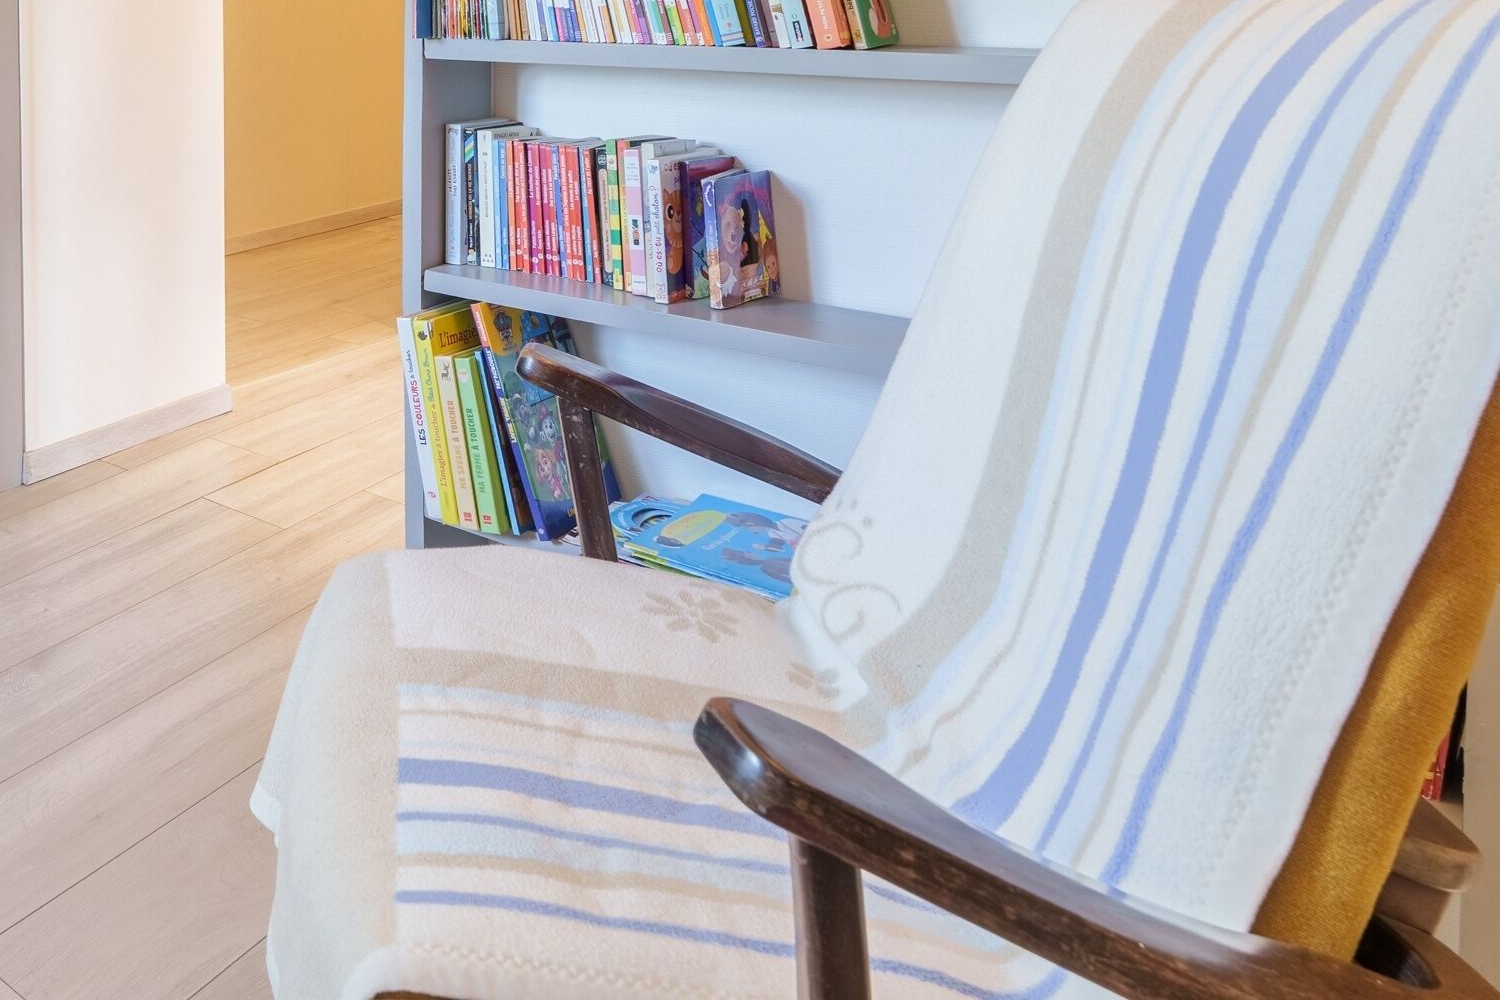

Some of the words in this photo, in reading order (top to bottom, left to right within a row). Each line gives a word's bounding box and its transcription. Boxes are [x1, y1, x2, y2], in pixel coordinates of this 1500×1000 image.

[746, 0, 756, 15] POCHE
[816, 0, 826, 14] PETIT
[750, 16, 761, 35] BAYARD
[649, 192, 660, 219] chaton
[409, 379, 424, 426] COULEURS
[430, 410, 442, 441] toucher
[445, 400, 459, 433] TOUCHER
[464, 408, 478, 442] TOUCHER
[417, 429, 427, 445] LES
[434, 449, 450, 486] L'imagier
[452, 445, 465, 474] SAVANE
[472, 452, 484, 478] FERME
[458, 477, 468, 489] MA
[477, 481, 487, 493] MA
